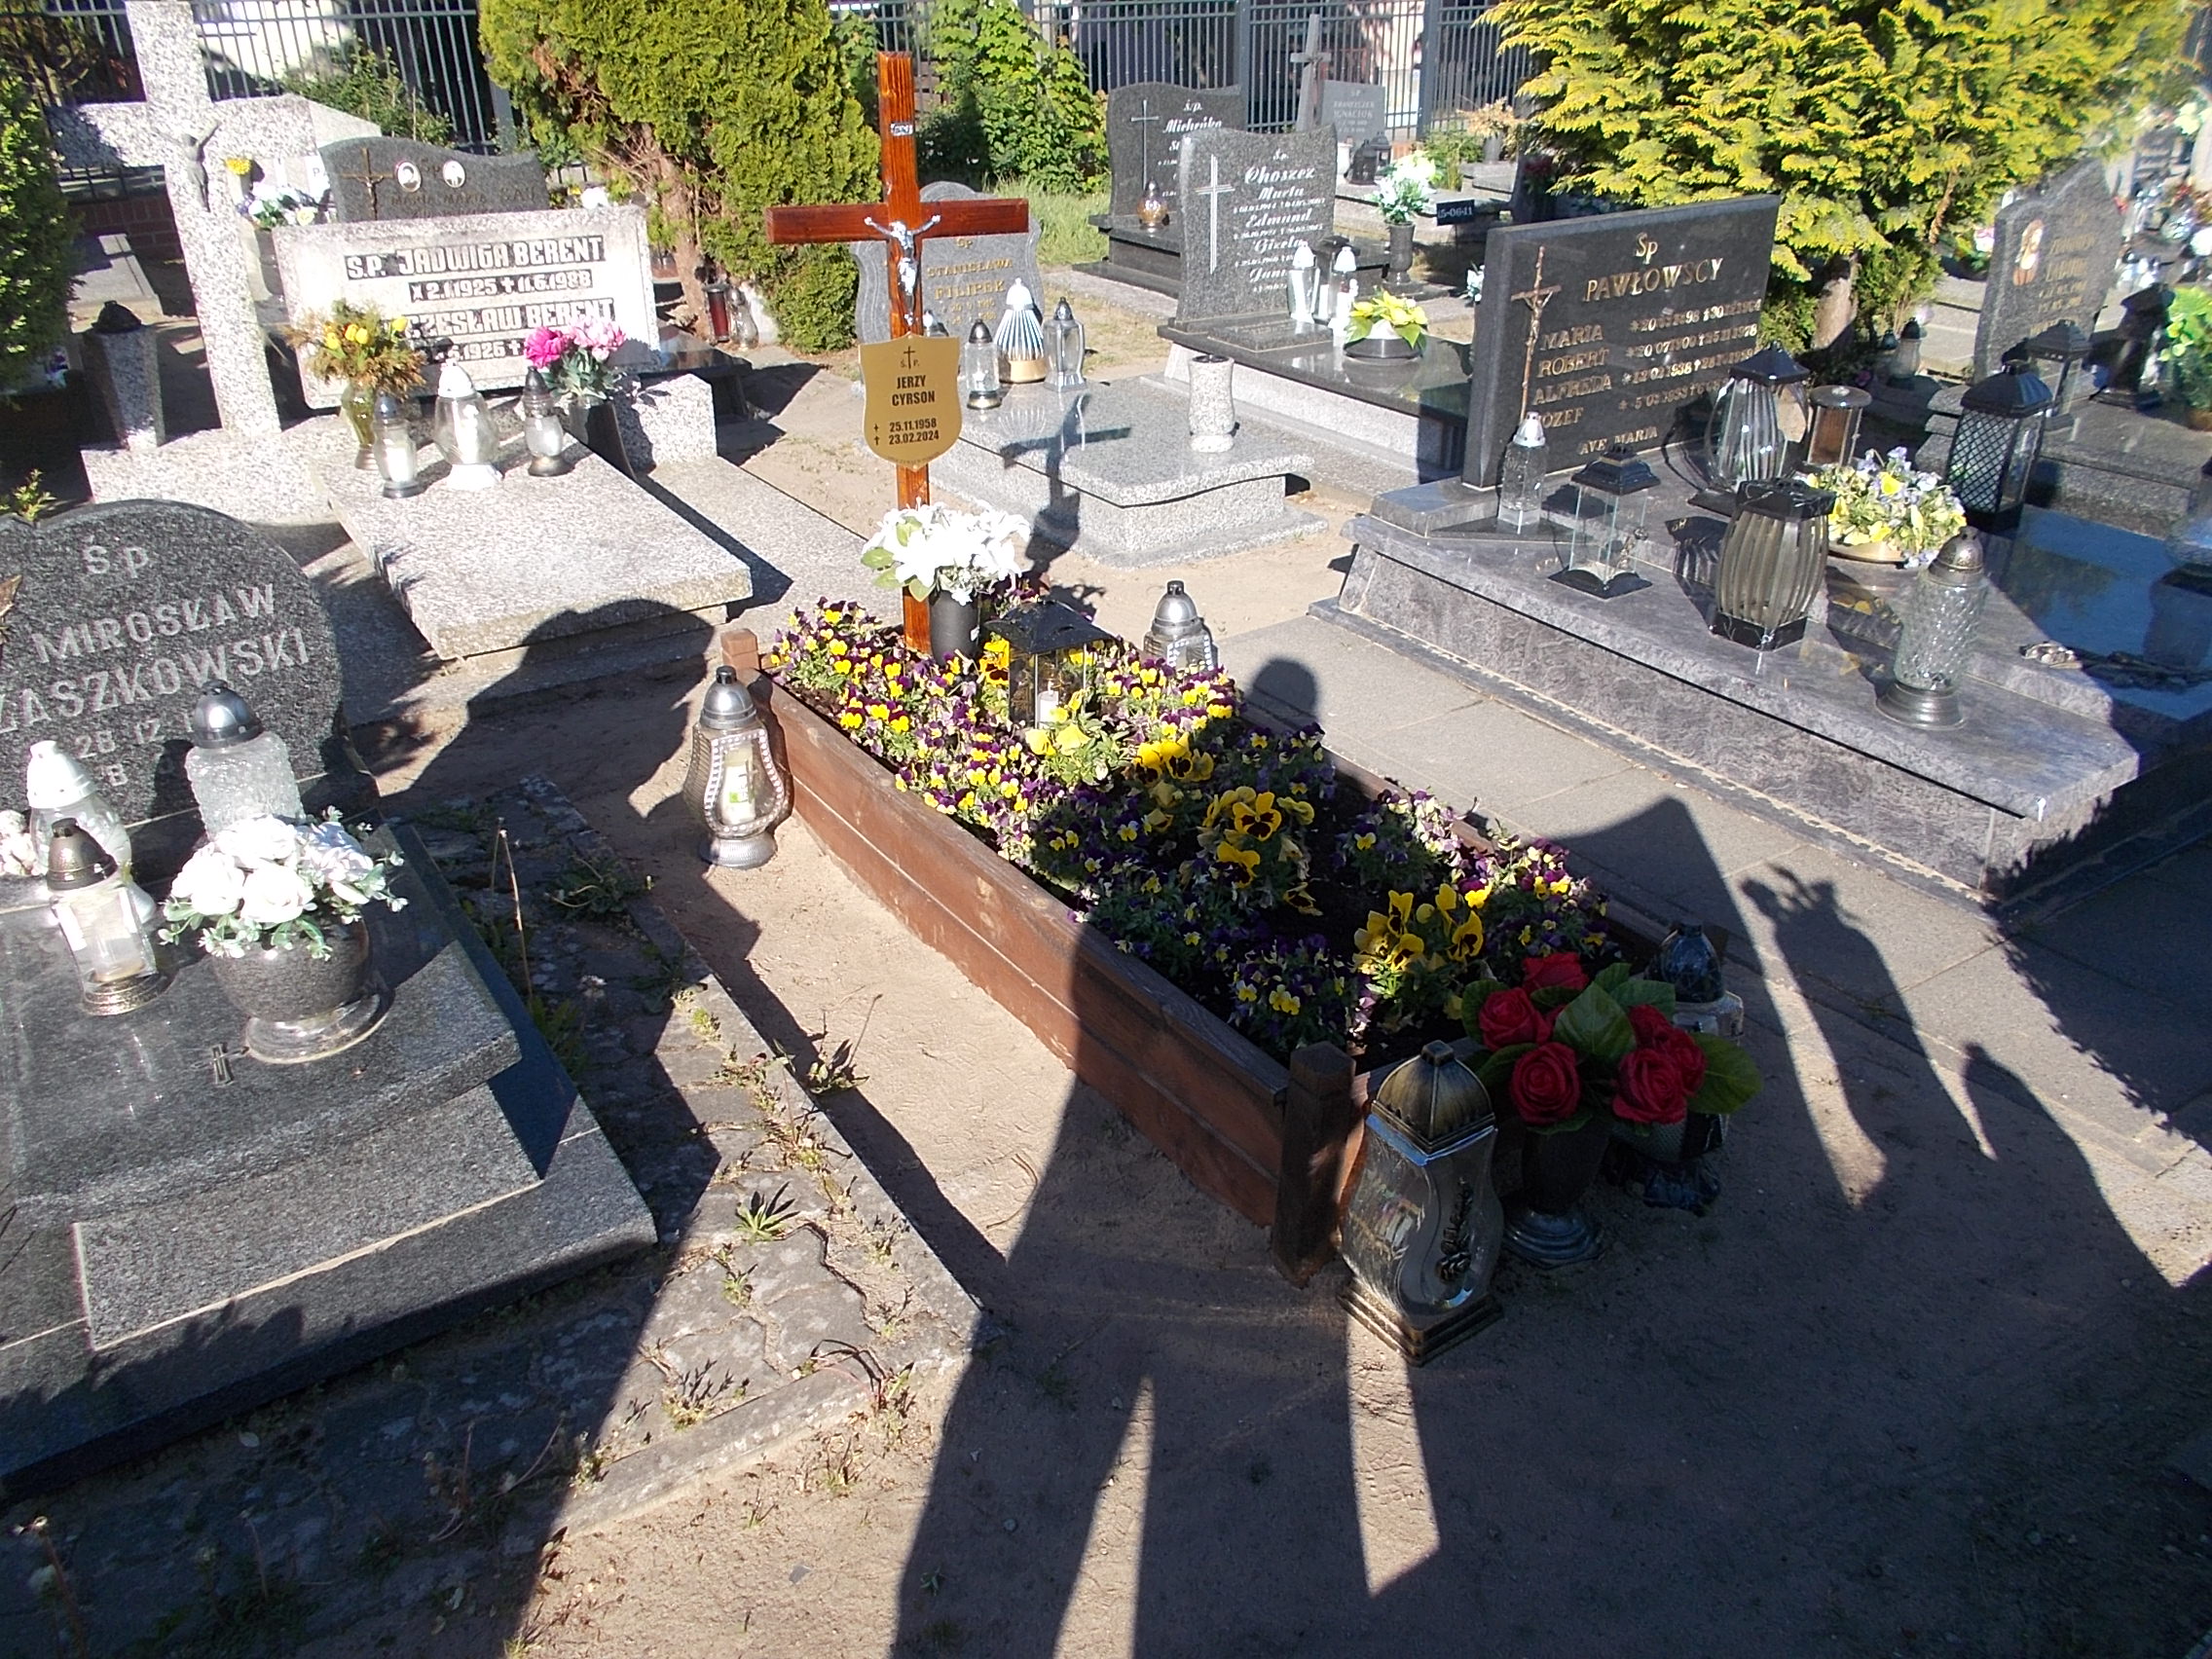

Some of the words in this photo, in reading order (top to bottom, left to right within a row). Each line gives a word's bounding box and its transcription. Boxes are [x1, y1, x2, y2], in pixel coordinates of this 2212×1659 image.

[1245, 208, 1313, 228] Edmund
[397, 243, 511, 276] JADWIGA
[513, 237, 603, 268] BERENT
[934, 279, 1006, 301] FILIPEK
[1583, 257, 1723, 303] PAWŁOWSCY
[404, 304, 522, 339] CZESŁAW
[1540, 323, 1604, 351] MARIA
[1536, 348, 1610, 379] ROBERT
[896, 374, 927, 390] JERZY
[891, 389, 936, 407] CYRSON
[888, 429, 940, 446] 23.02.2024
[889, 417, 938, 433] 25.11.1958
[1578, 437, 1608, 456] AVE
[1614, 425, 1658, 445] MARIA
[31, 583, 275, 664] MIROSŁAW
